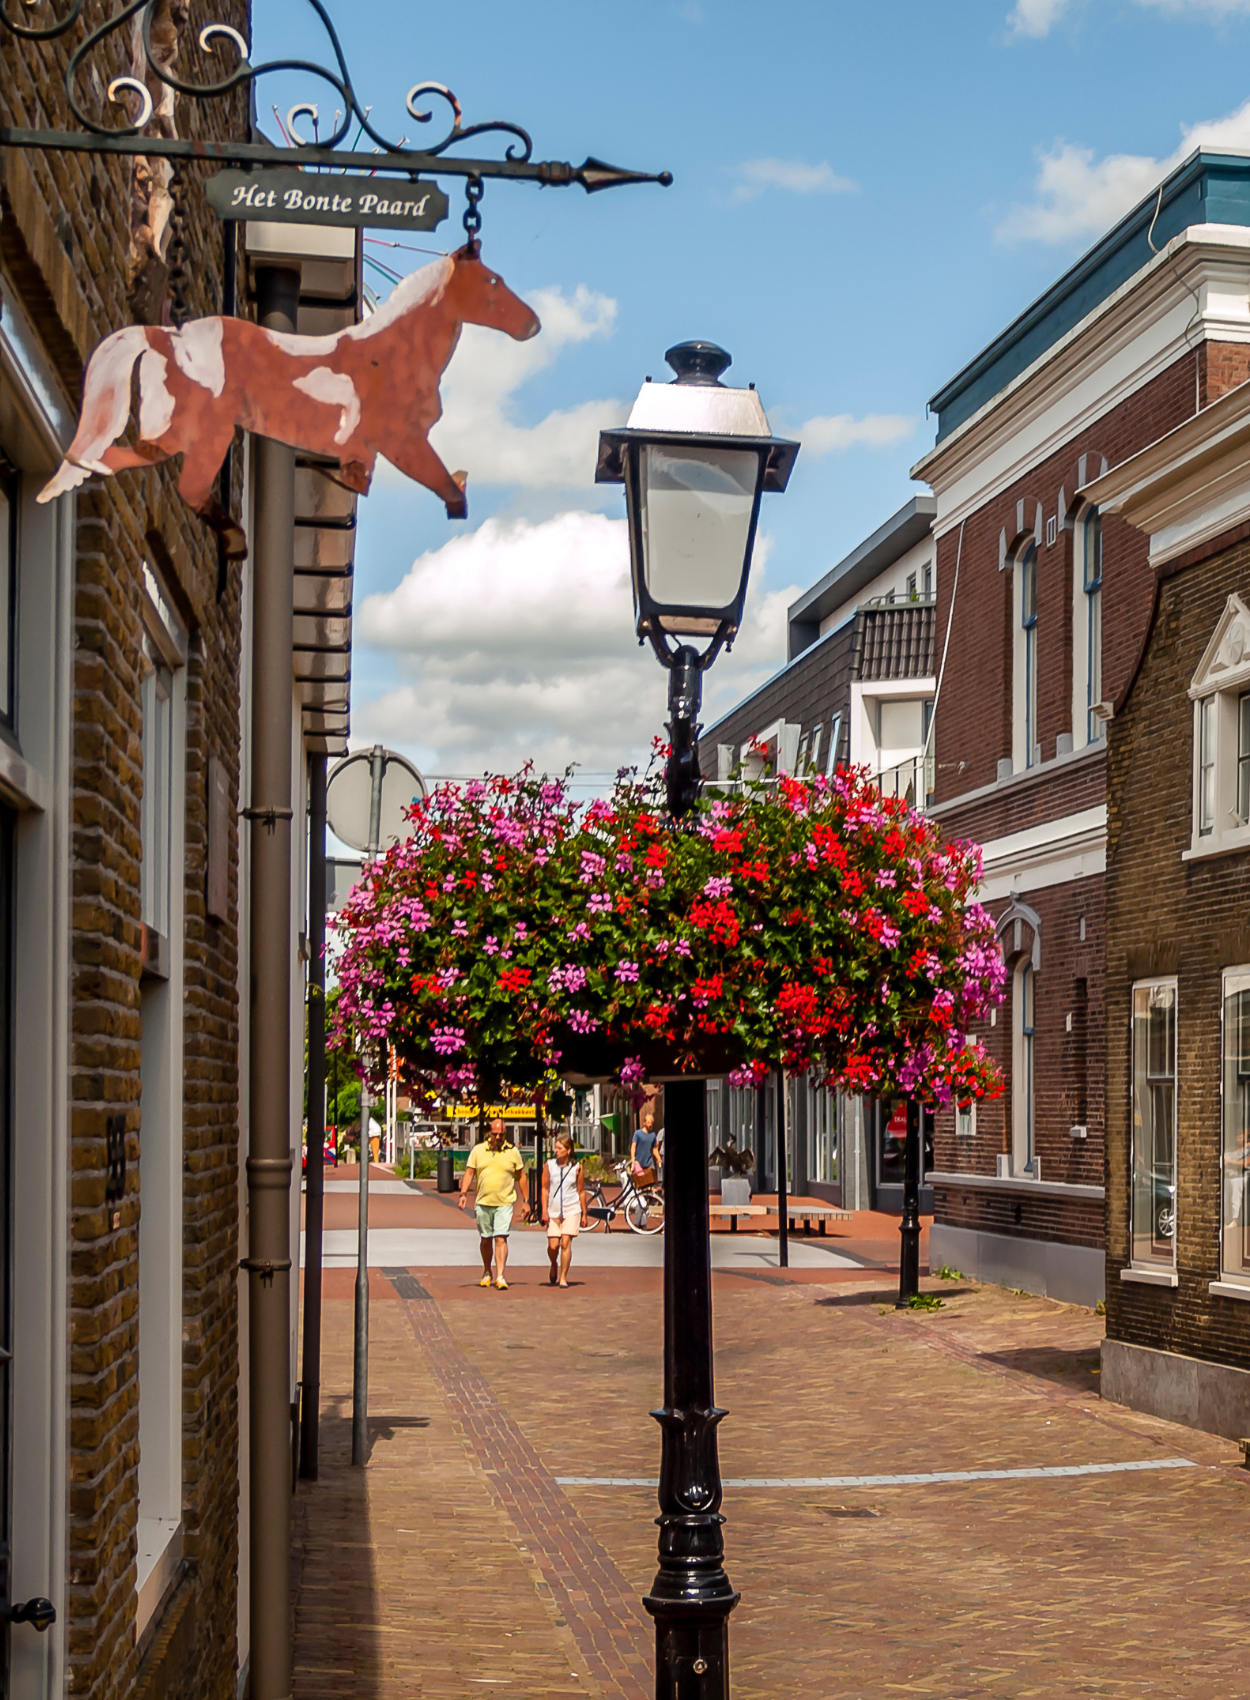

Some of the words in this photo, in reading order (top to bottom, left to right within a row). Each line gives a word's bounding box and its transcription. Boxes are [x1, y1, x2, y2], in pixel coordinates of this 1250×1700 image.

[231, 184, 277, 207] Het
[284, 189, 352, 213] Bonte
[359, 194, 430, 217] Paard
